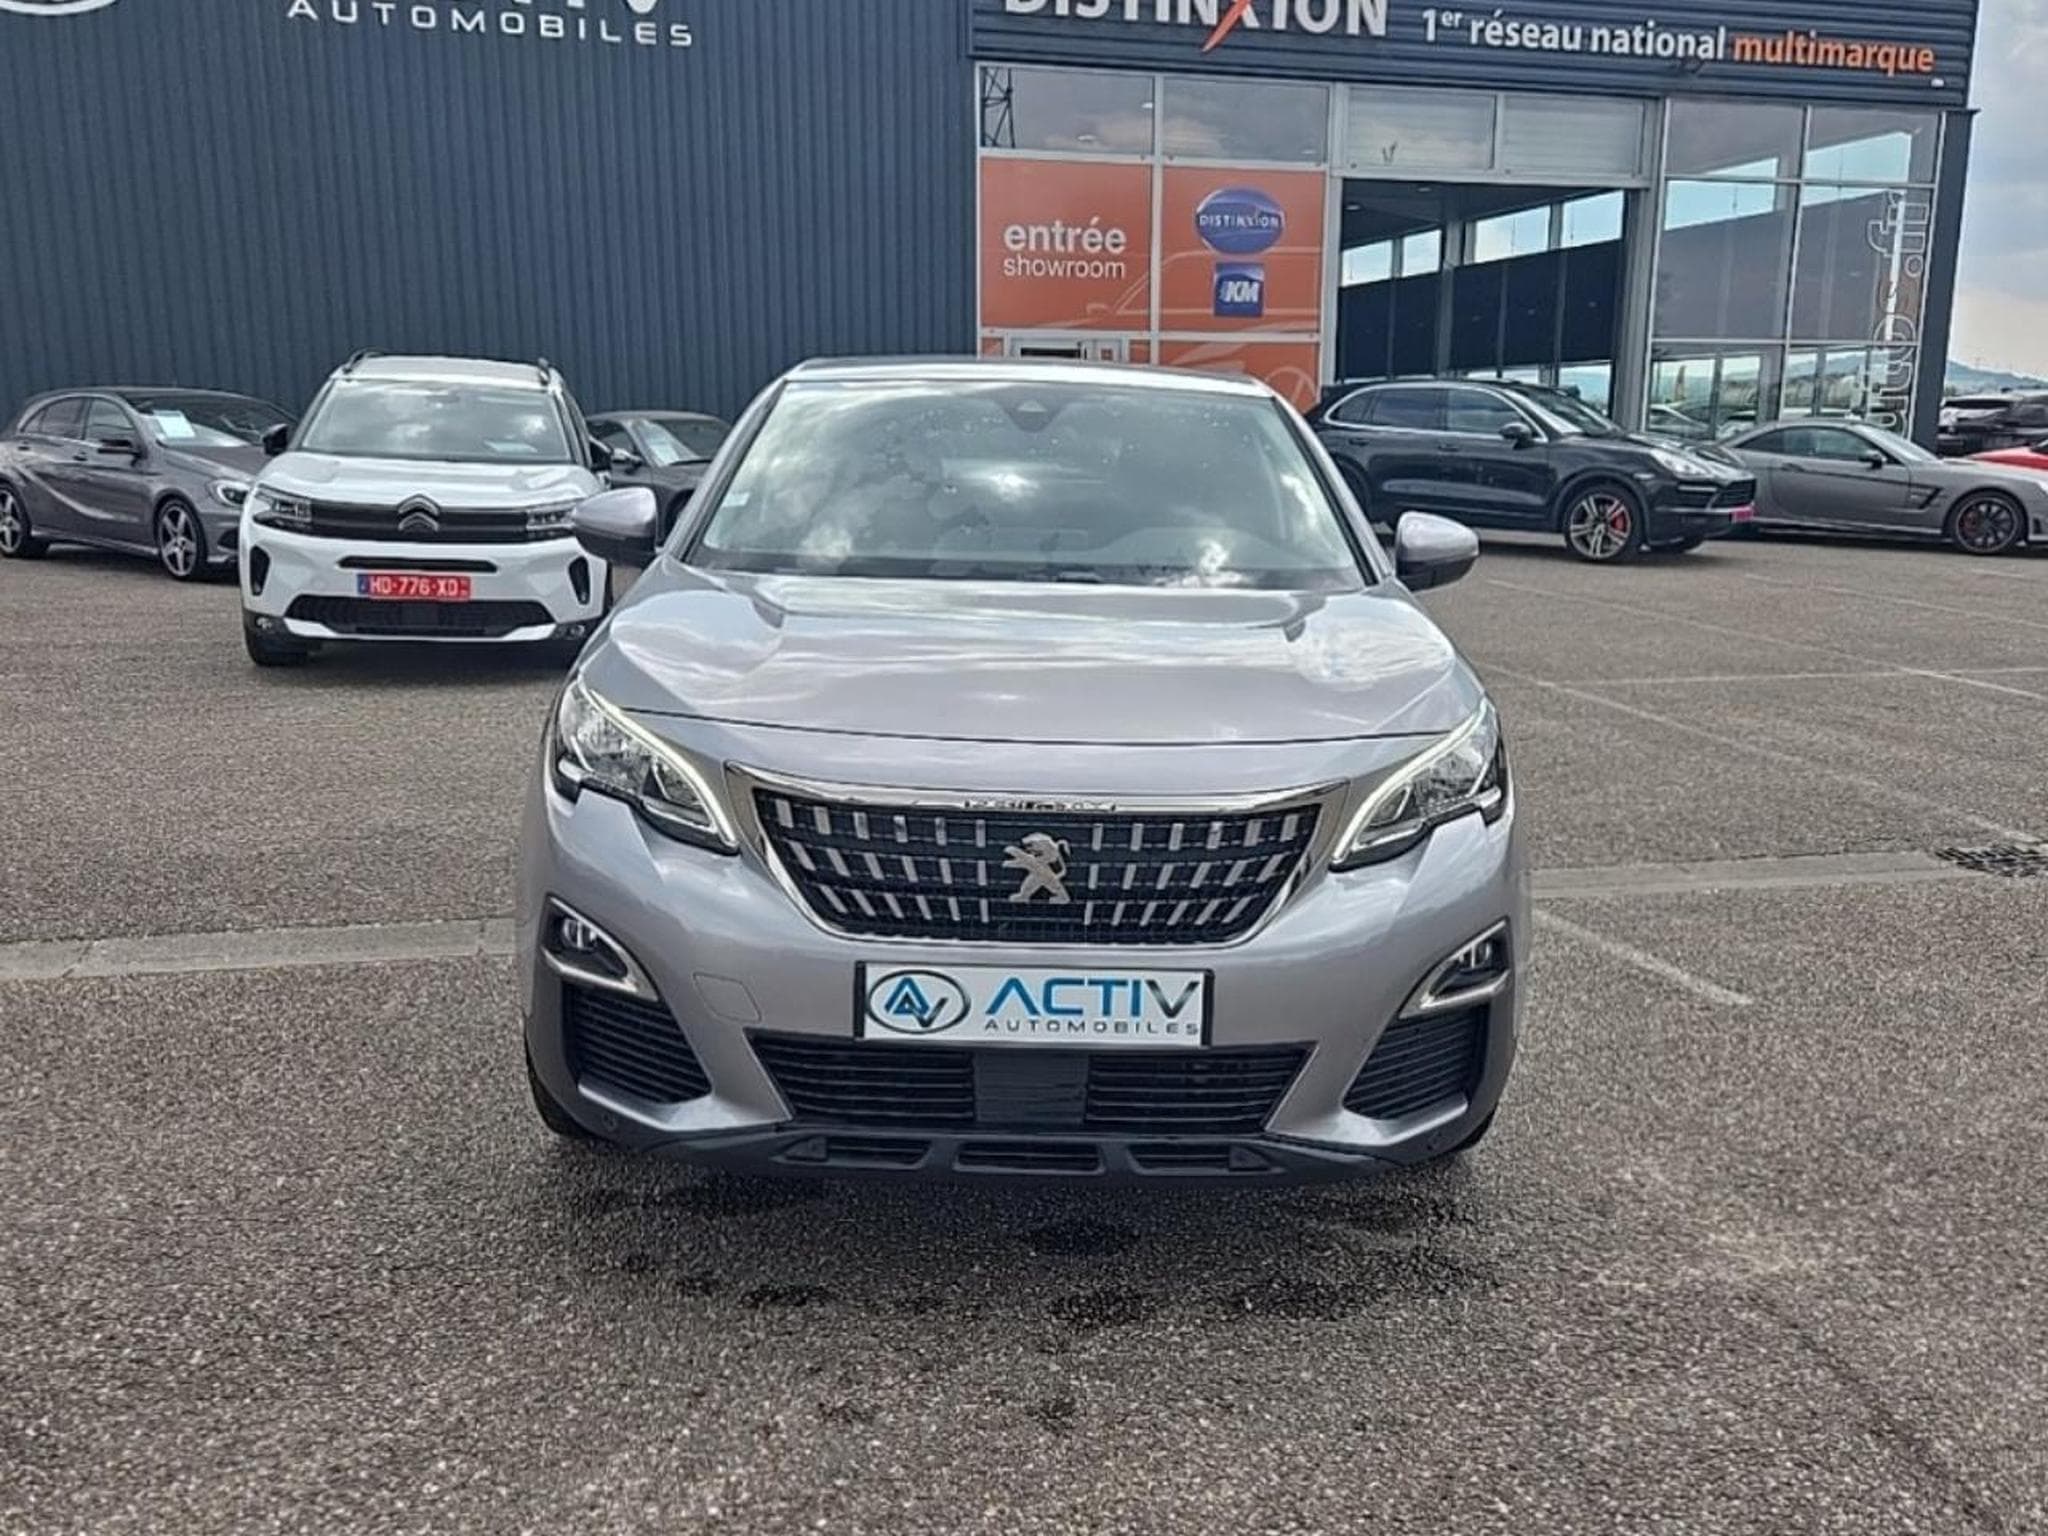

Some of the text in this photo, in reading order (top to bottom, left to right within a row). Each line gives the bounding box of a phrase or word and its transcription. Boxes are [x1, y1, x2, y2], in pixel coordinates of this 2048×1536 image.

[287, 0, 693, 46] AUTOMOBILES
[1469, 12, 1583, 51] réseau
[1590, 27, 1725, 60] national
[1732, 32, 1936, 76] multimarque
[1003, 216, 1127, 254] entrée
[1003, 254, 1126, 280] showroom
[985, 976, 1200, 1019] ACTIV
[984, 1018, 1199, 1035] AUTOMOBILES
